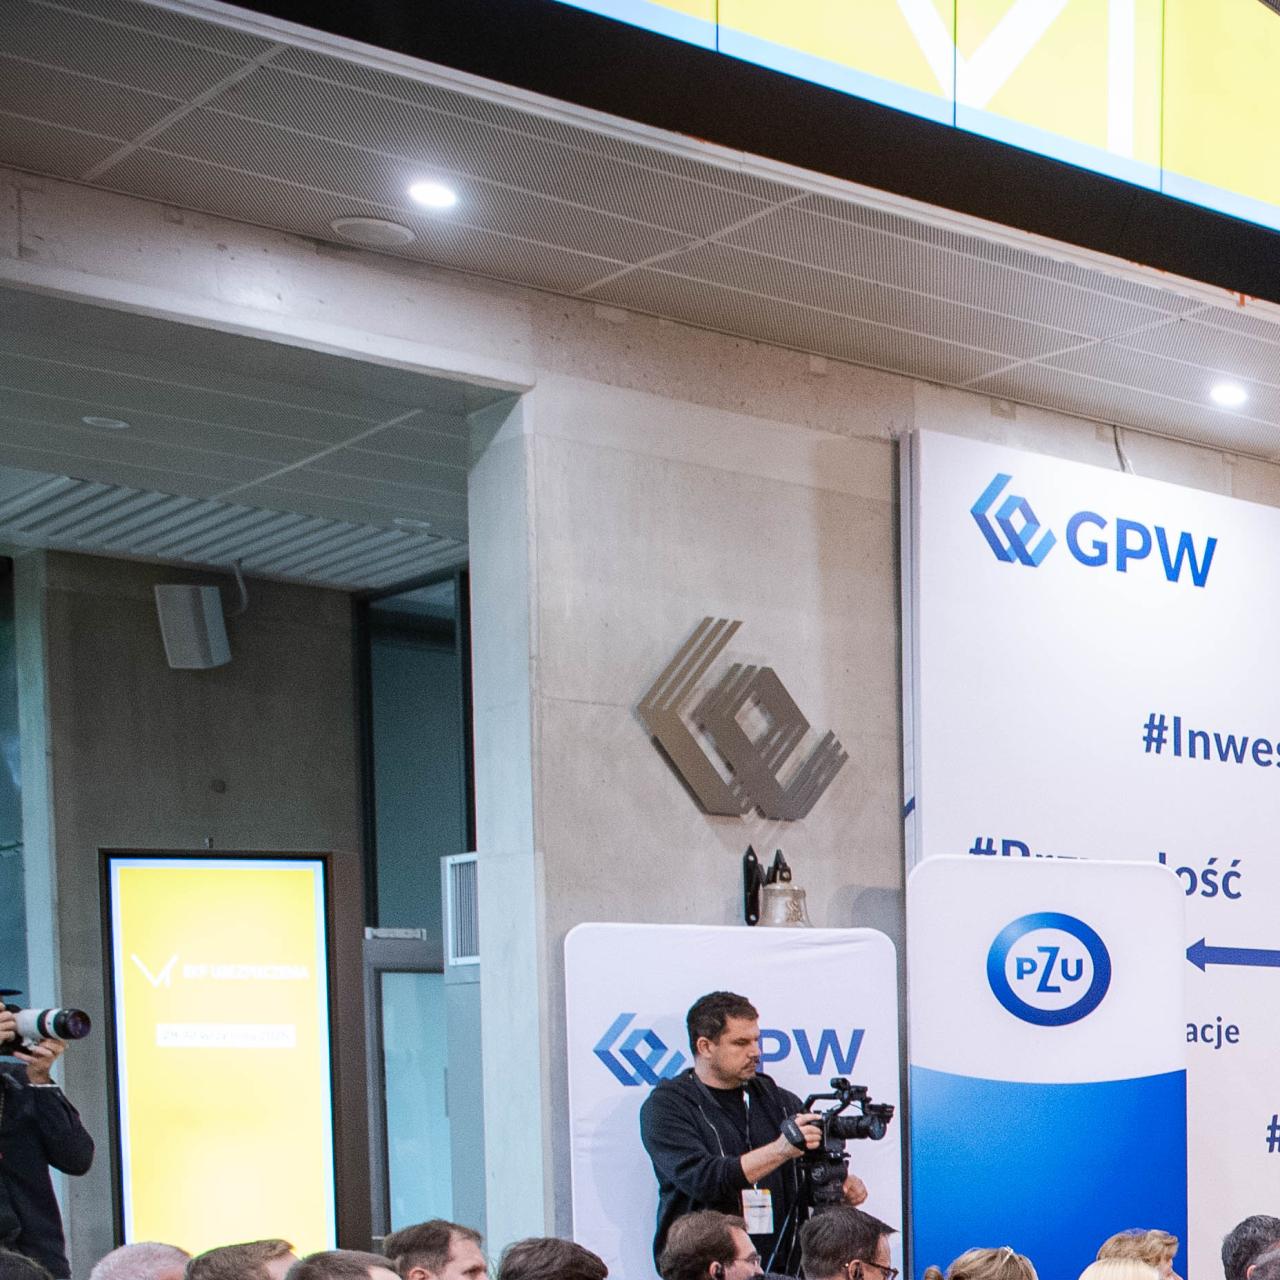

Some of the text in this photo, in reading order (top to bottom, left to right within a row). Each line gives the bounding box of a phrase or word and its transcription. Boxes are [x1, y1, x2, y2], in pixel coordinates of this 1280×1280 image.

[1065, 510, 1218, 588] GPW
[1015, 945, 1084, 993] PZU
[757, 1028, 866, 1076] PW
